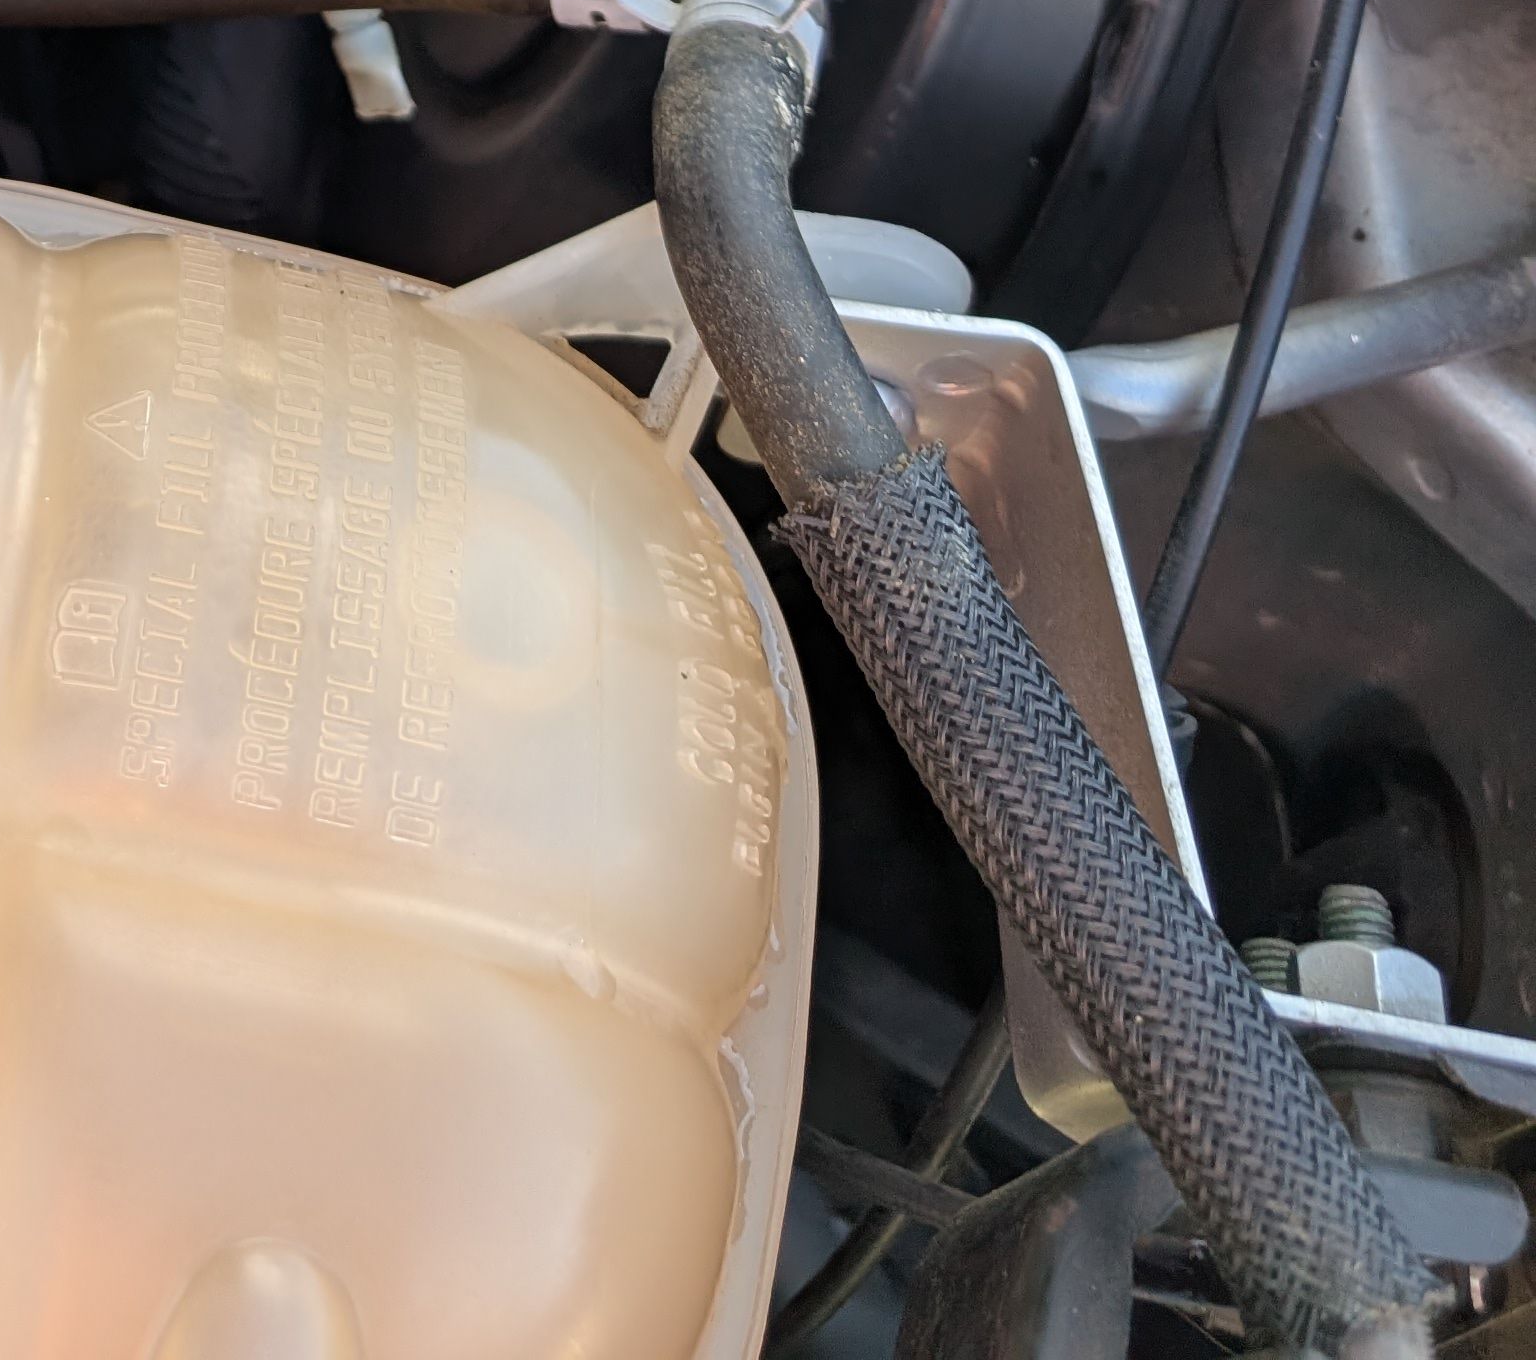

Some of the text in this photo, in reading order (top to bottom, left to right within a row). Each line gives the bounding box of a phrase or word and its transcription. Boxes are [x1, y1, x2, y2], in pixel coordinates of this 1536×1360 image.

[155, 426, 213, 536] FILL
[347, 404, 395, 464] DU
[119, 561, 198, 788] SPECIAL
[227, 517, 314, 810] PROCÉDURE
[309, 478, 394, 830] REMPLISSAGE
[677, 658, 737, 783] COLD
[385, 770, 444, 847] DE
